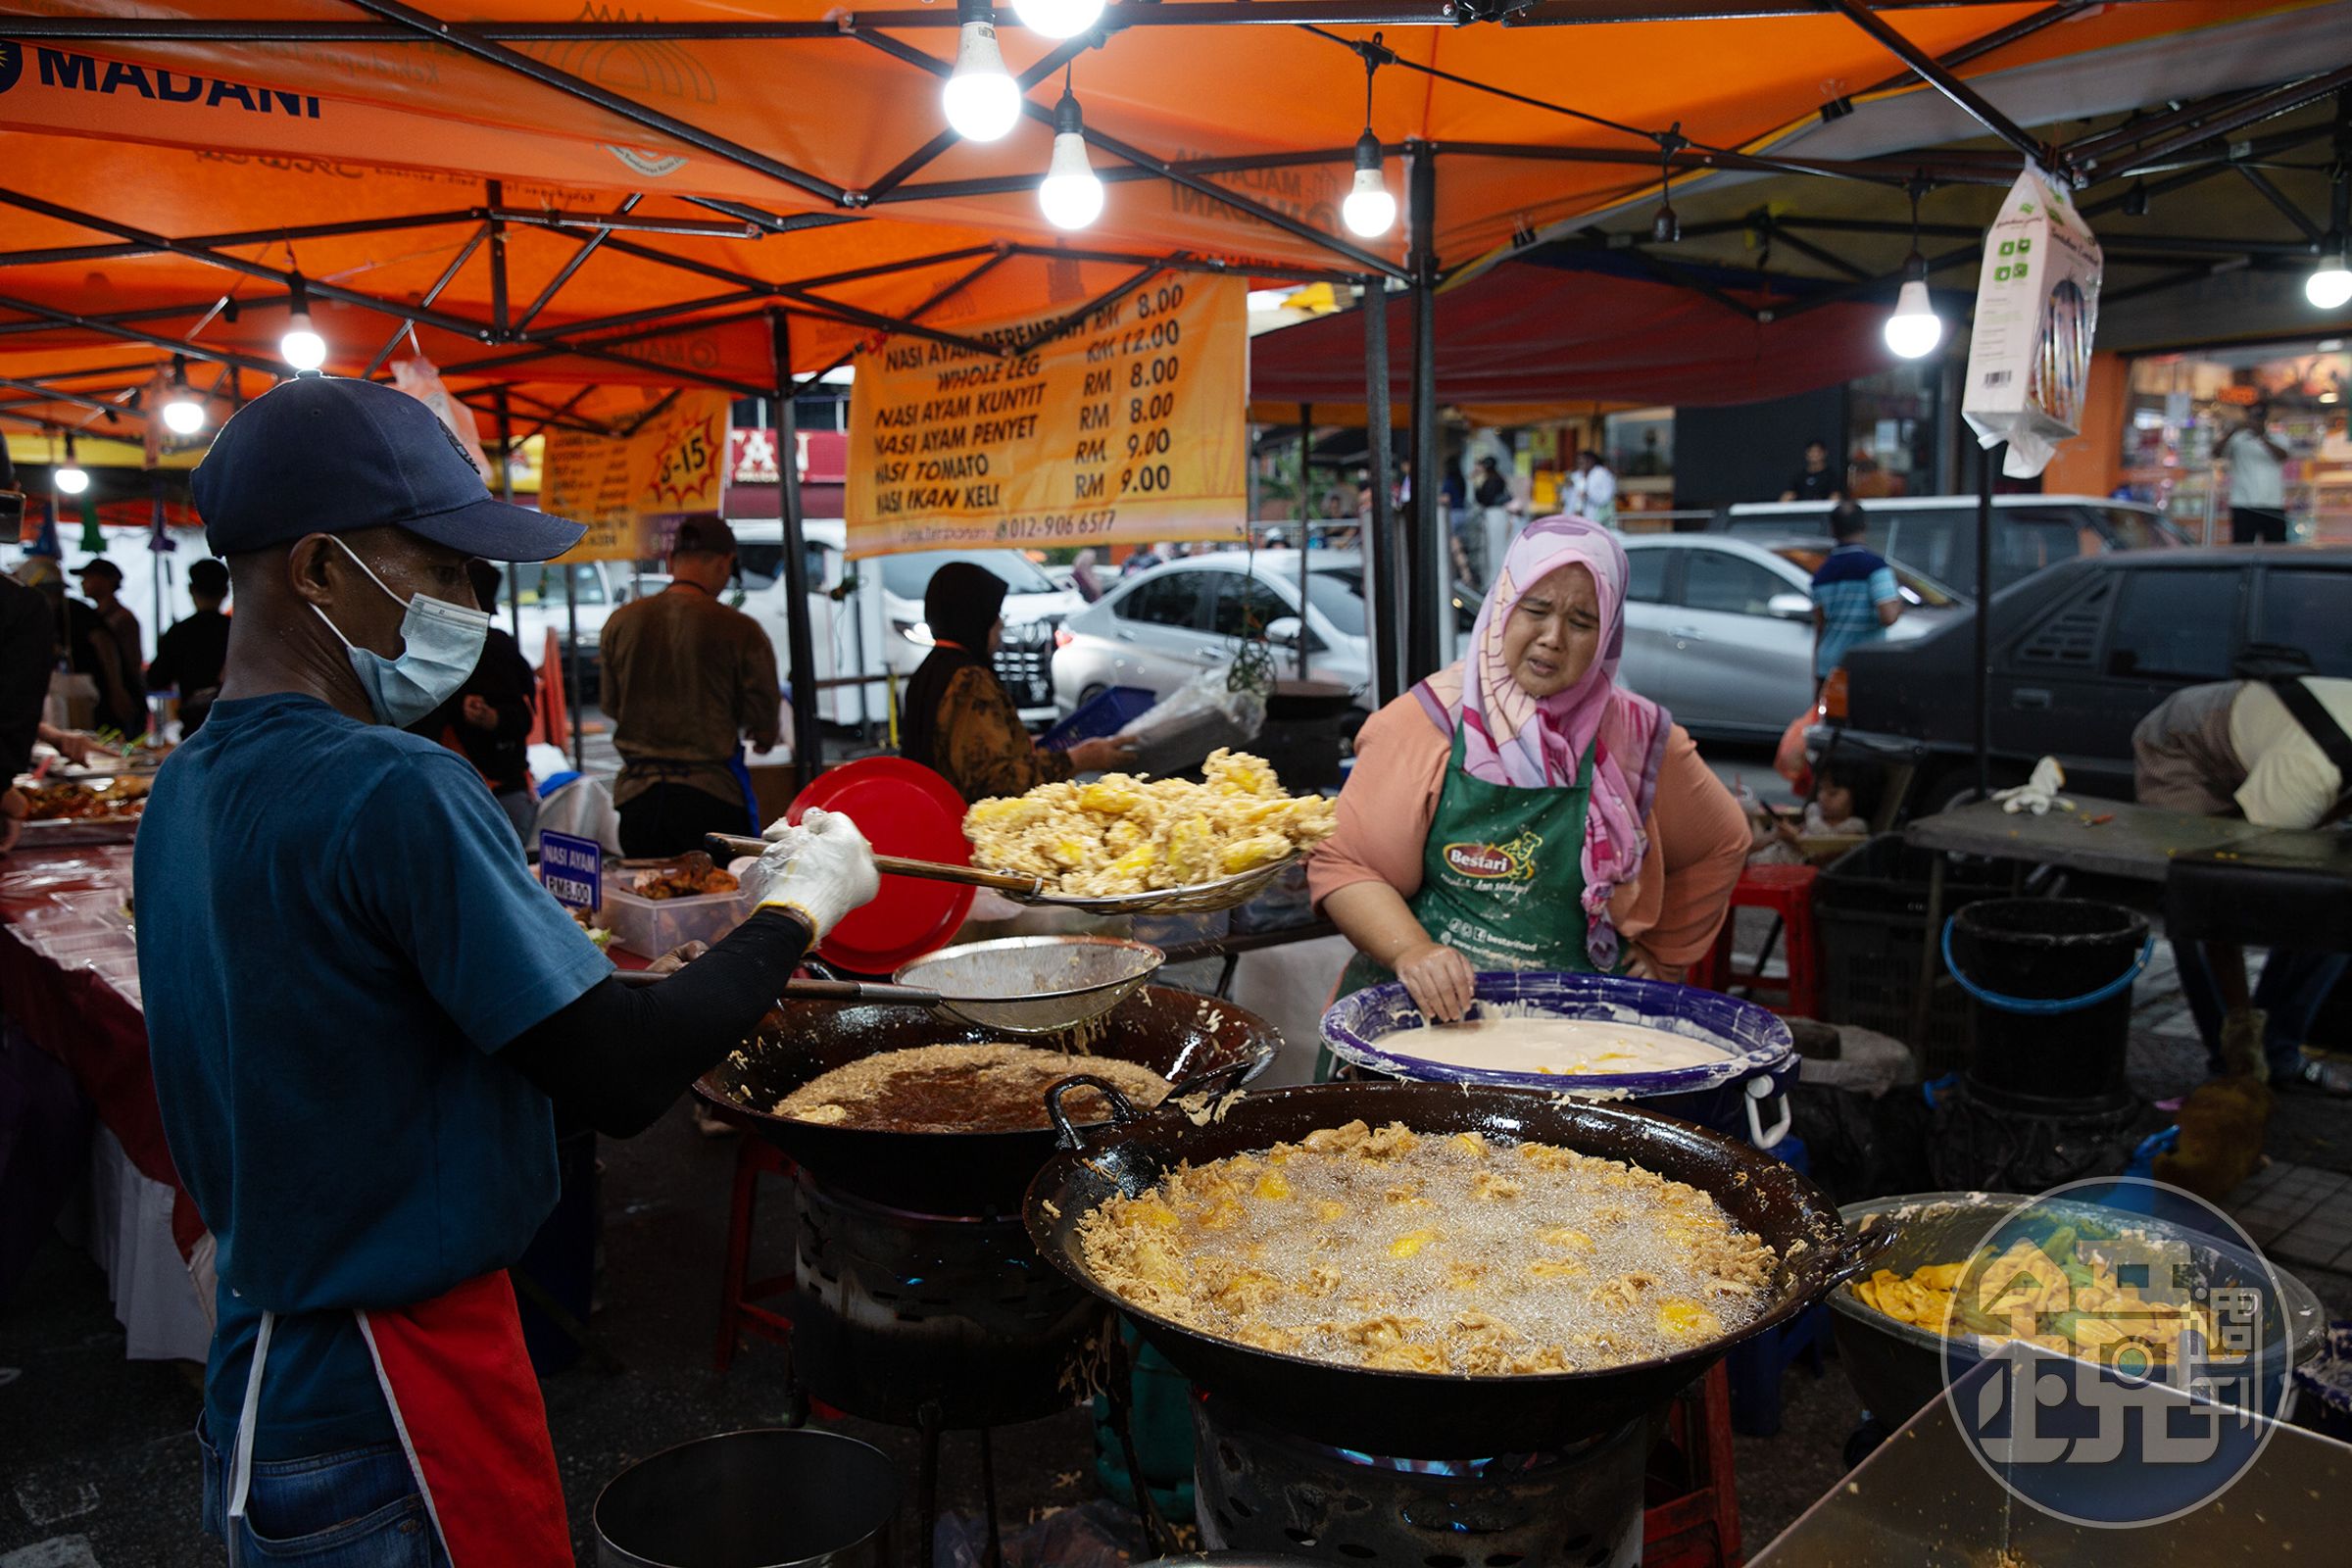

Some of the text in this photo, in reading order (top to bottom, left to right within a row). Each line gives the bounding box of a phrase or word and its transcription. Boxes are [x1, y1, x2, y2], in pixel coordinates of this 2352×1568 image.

[885, 344, 923, 372] NASI
[1092, 303, 1121, 331] RM
[1137, 284, 1184, 319] 8.00
[937, 318, 1180, 392] WHOLE LEG RM 12.00
[874, 356, 1179, 428] NASI AYAM KUNYIT RM 8.00
[919, 426, 966, 454] AYAM
[971, 414, 1038, 447] PENYET
[1079, 403, 1109, 431] RM
[1130, 392, 1174, 423] 8.00
[915, 454, 989, 482] TOMATO
[1075, 438, 1106, 465] RM
[1127, 427, 1170, 459] 9.00
[907, 489, 959, 511] IKAN
[964, 483, 1000, 510] KELI
[1075, 473, 1104, 499] RM
[1122, 465, 1170, 493] 9.00
[1009, 515, 1074, 539] 012-906
[1079, 510, 1116, 533] 6577
[545, 845, 596, 874] NASI AYAM
[1450, 849, 1507, 872] Bestari
[1473, 879, 1494, 892] dan
[1487, 932, 1538, 953] bestarifood
